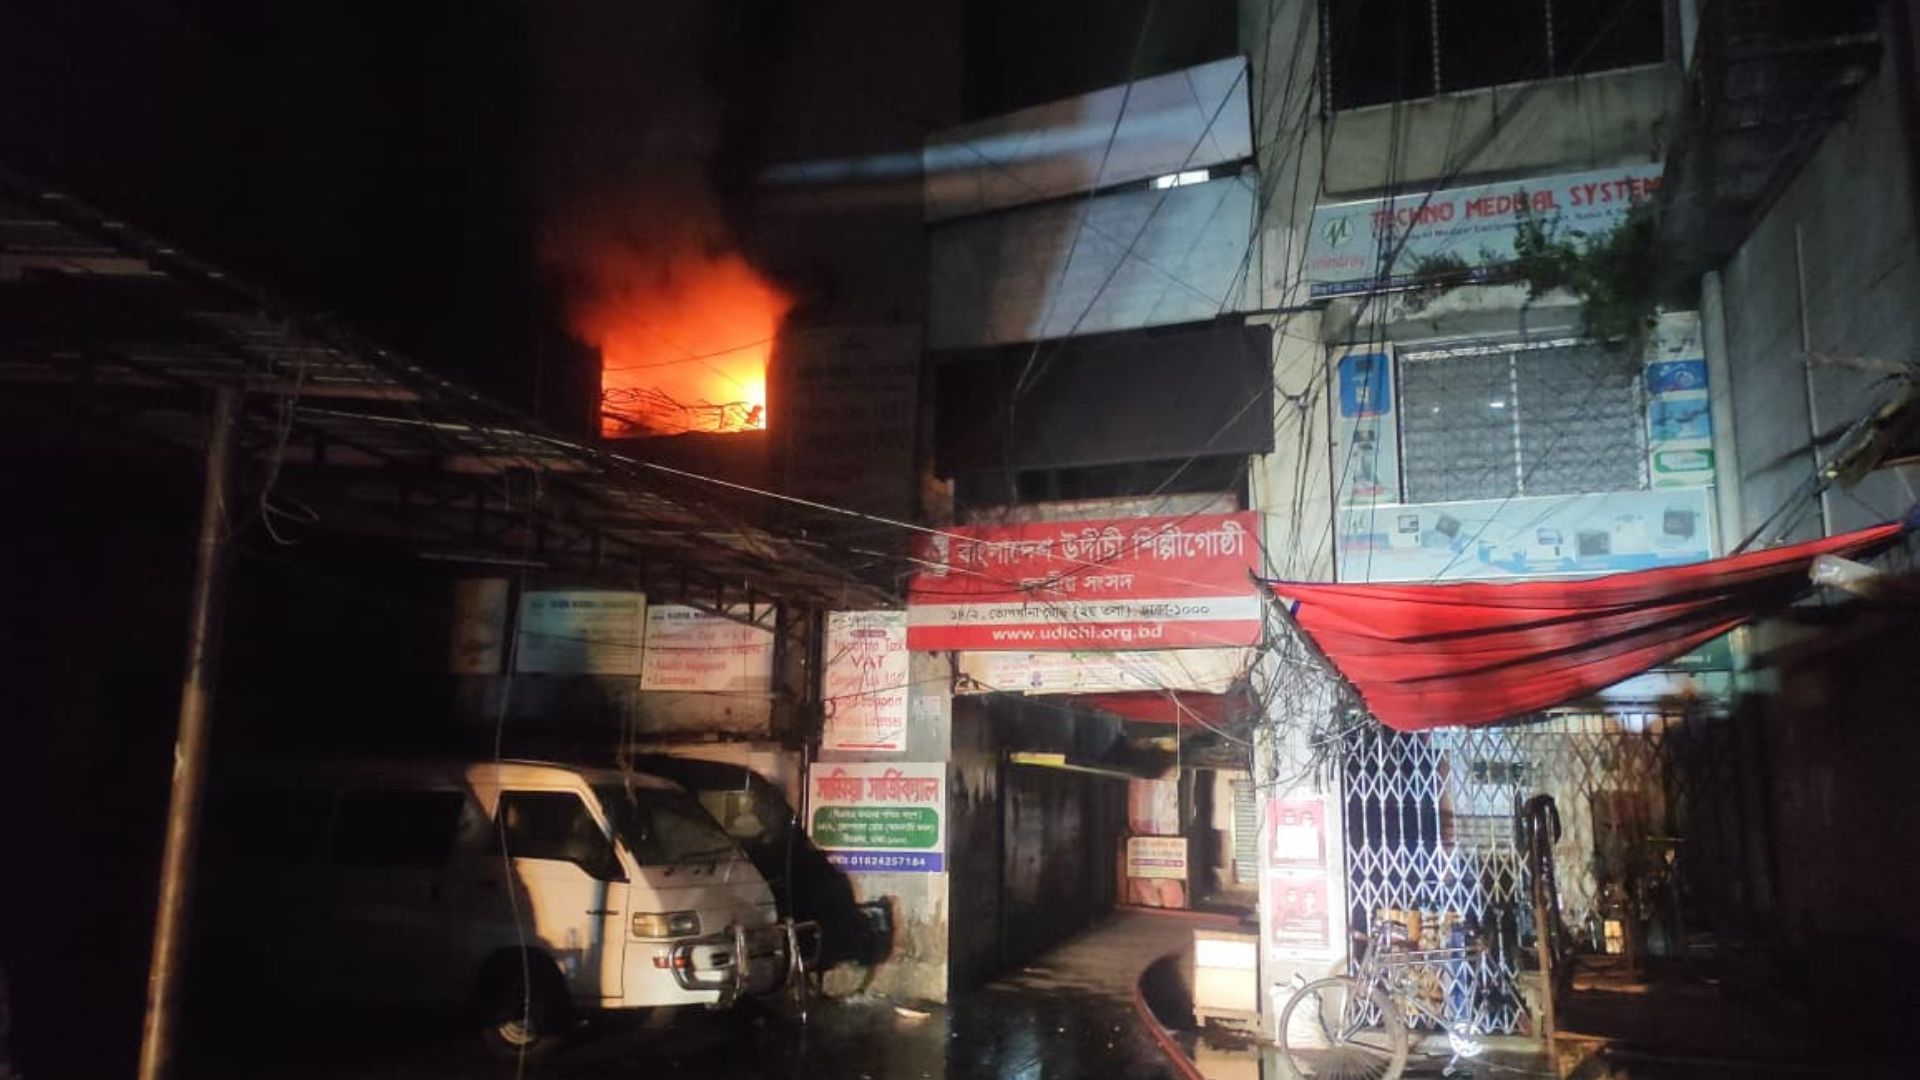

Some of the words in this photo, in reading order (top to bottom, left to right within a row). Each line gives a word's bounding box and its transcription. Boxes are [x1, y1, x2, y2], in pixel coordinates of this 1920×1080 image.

[1370, 202, 1455, 229] TECHNO
[956, 538, 1054, 567] বাংলাদেশ
[1060, 527, 1126, 561] উদীচী
[1131, 520, 1248, 561] শিল্পীগোষ্ঠী
[1083, 574, 1134, 592] সংসদ
[992, 625, 1163, 641] www.udichi.org.bd
[850, 655, 885, 669] VAT
